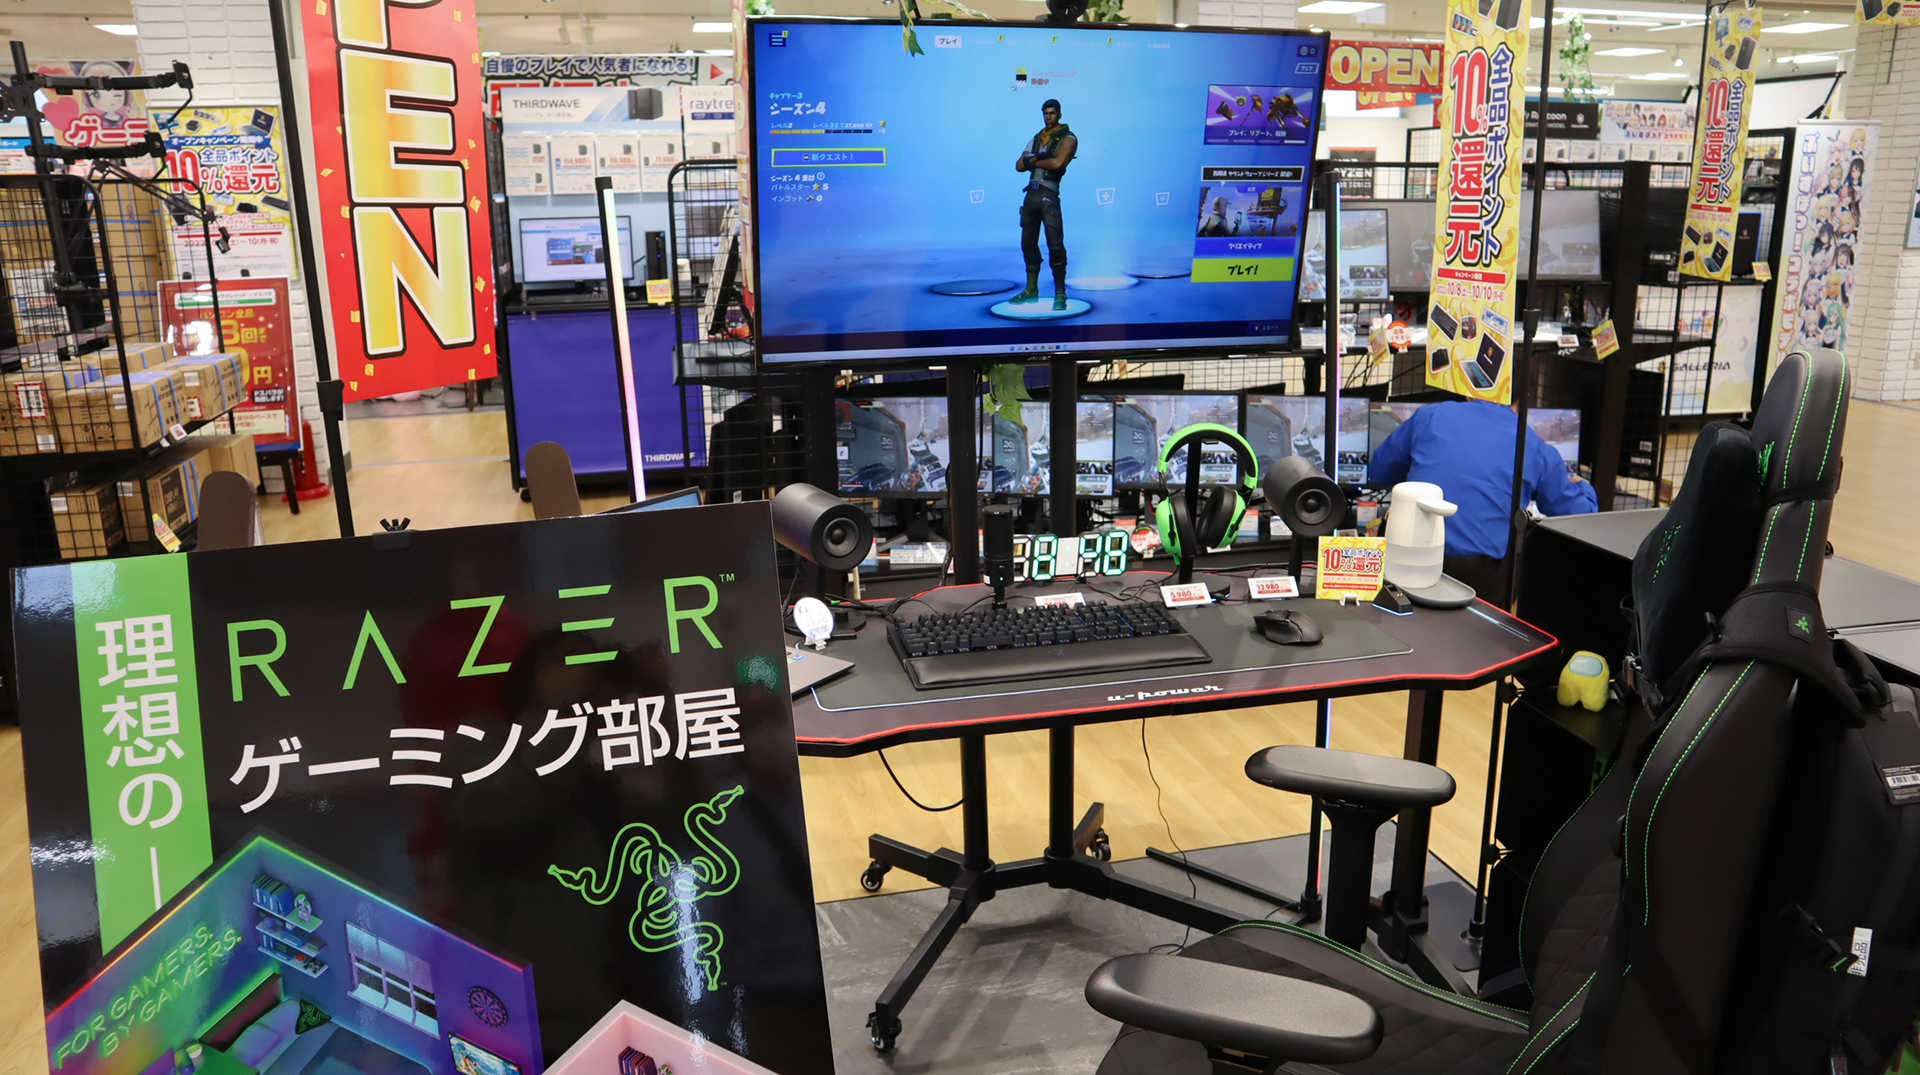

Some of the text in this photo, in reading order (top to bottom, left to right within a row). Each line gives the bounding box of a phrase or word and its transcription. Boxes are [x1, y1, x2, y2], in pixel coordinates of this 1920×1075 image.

[1329, 45, 1441, 86] OPEN
[513, 99, 580, 109] THIRDWAVE
[770, 102, 826, 115] シーズン4
[202, 148, 278, 164] 全品ポイント
[1446, 50, 1489, 262] 10%還元
[1483, 46, 1513, 264] 全品ポイント
[1719, 78, 1745, 203] 全品ポイント
[166, 149, 280, 194] 10%還元
[644, 452, 696, 463] THIRDWAE
[1323, 547, 1381, 573] 10%還元
[1343, 547, 1383, 558] 全品ポイント
[227, 575, 724, 702] RAZER
[1107, 685, 1224, 701] u-power
[229, 687, 745, 814] ゲーミング部屋
[54, 926, 215, 1069] FOR GAMERS.
[103, 929, 243, 1059] BY GAMERS.
